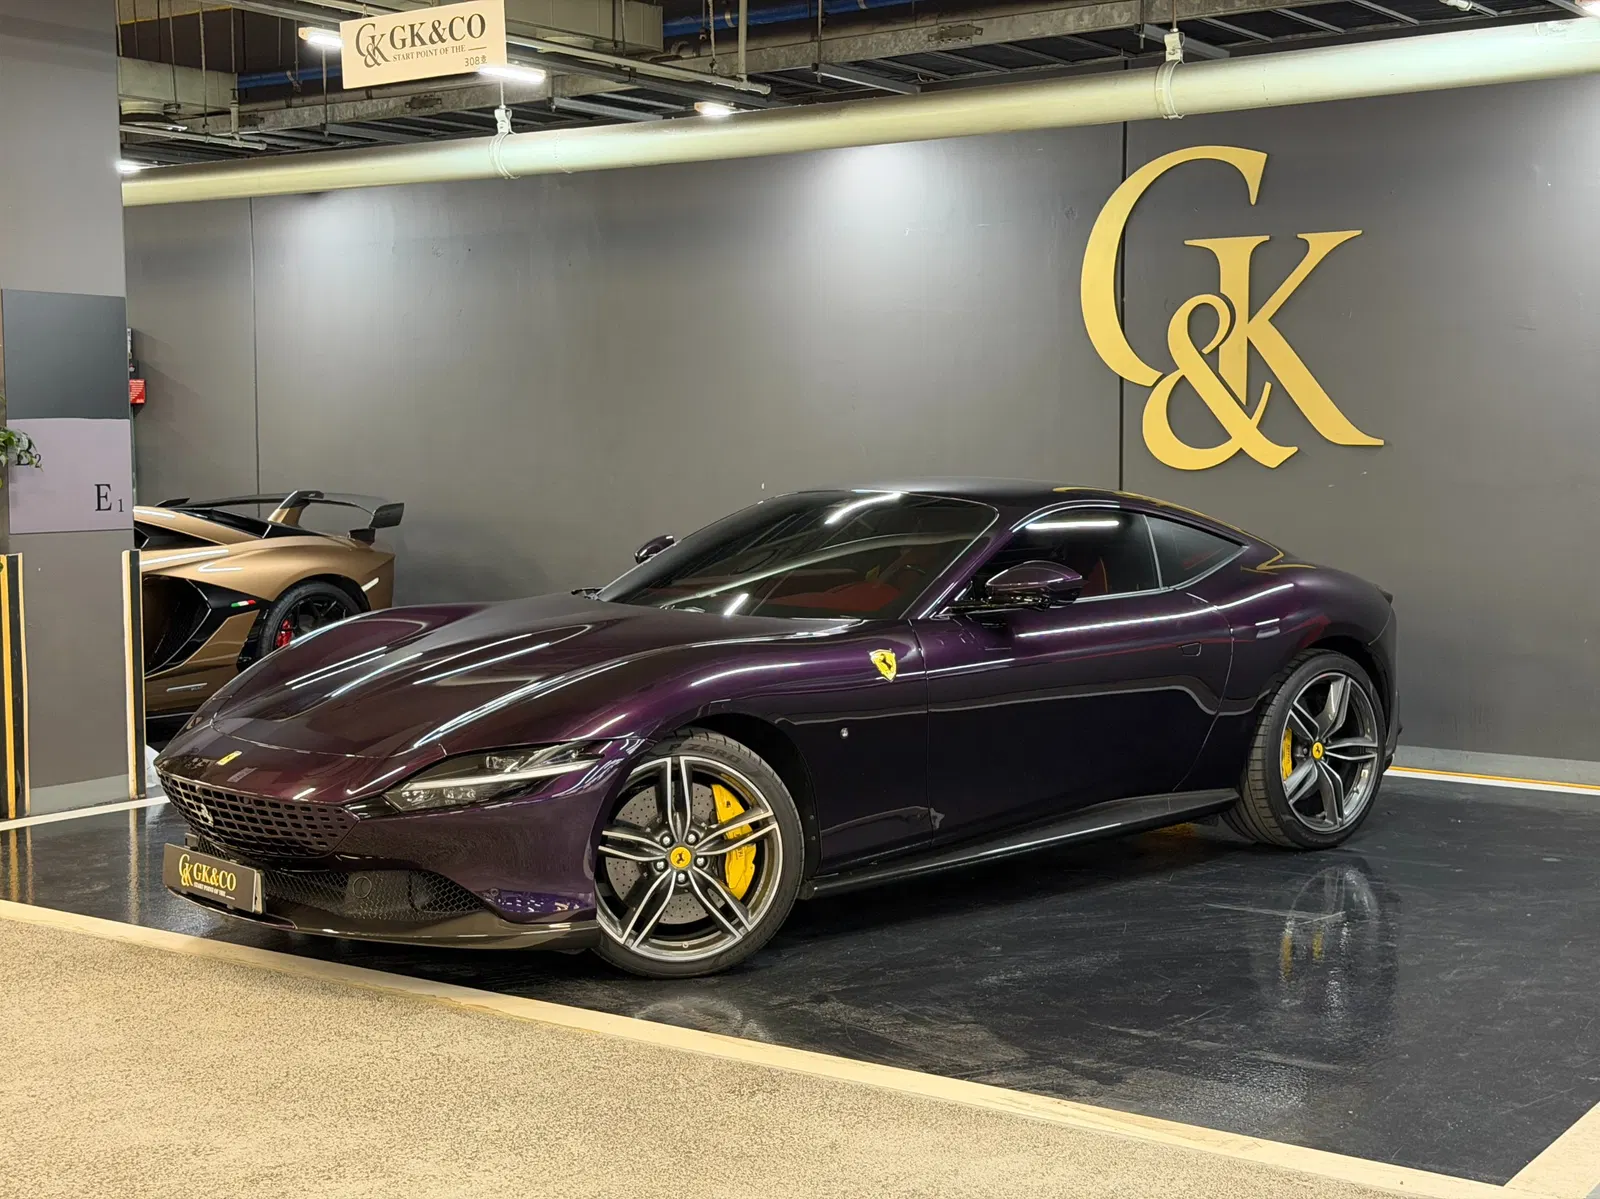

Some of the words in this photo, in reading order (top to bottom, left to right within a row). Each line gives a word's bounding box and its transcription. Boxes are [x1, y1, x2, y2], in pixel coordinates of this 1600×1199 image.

[390, 13, 486, 50] GK&CO
[393, 53, 415, 62] START
[416, 49, 437, 59] POINT
[439, 48, 450, 56] OF
[451, 45, 466, 54] THE
[684, 743, 741, 762] ZERO
[193, 862, 237, 891] GK&CO
